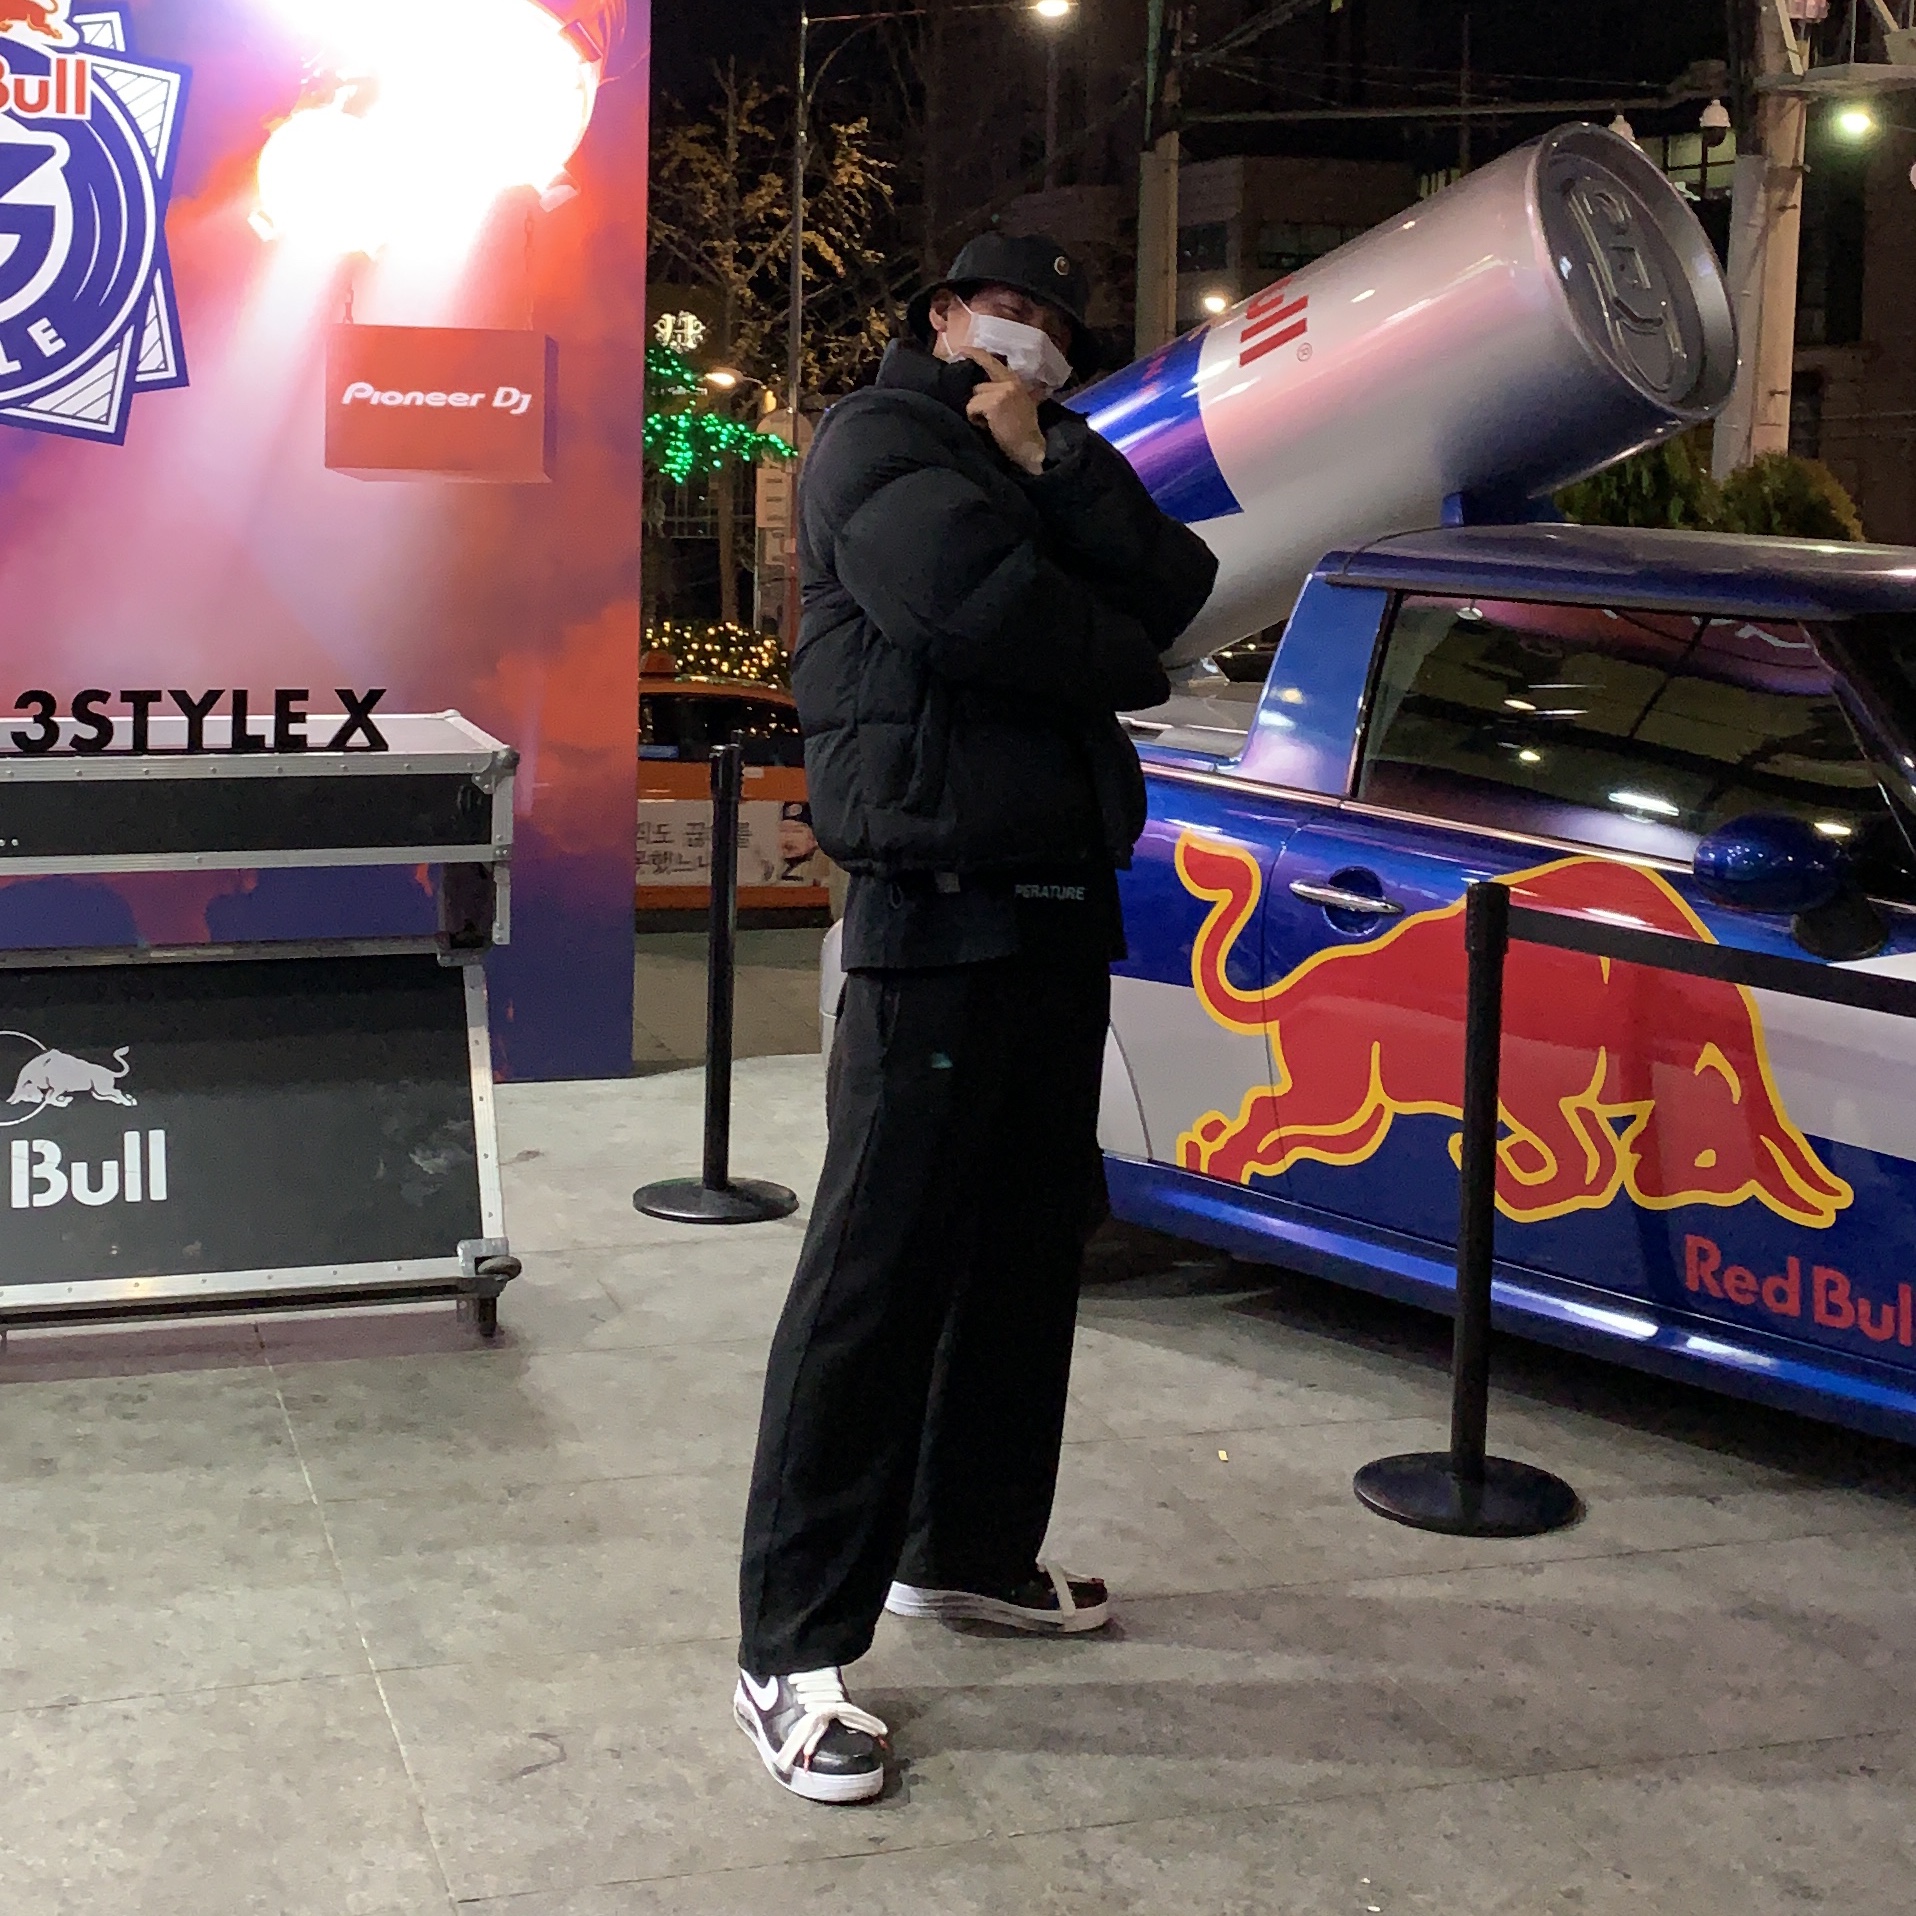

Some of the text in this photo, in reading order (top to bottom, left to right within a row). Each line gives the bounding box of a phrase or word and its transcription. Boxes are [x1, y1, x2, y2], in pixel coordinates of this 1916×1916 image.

[0, 56, 87, 115] ull
[341, 381, 486, 407] Pioneer
[10, 688, 389, 752] 3STYLE X
[11, 1129, 168, 1209] Bull
[1684, 1233, 1800, 1318] Red
